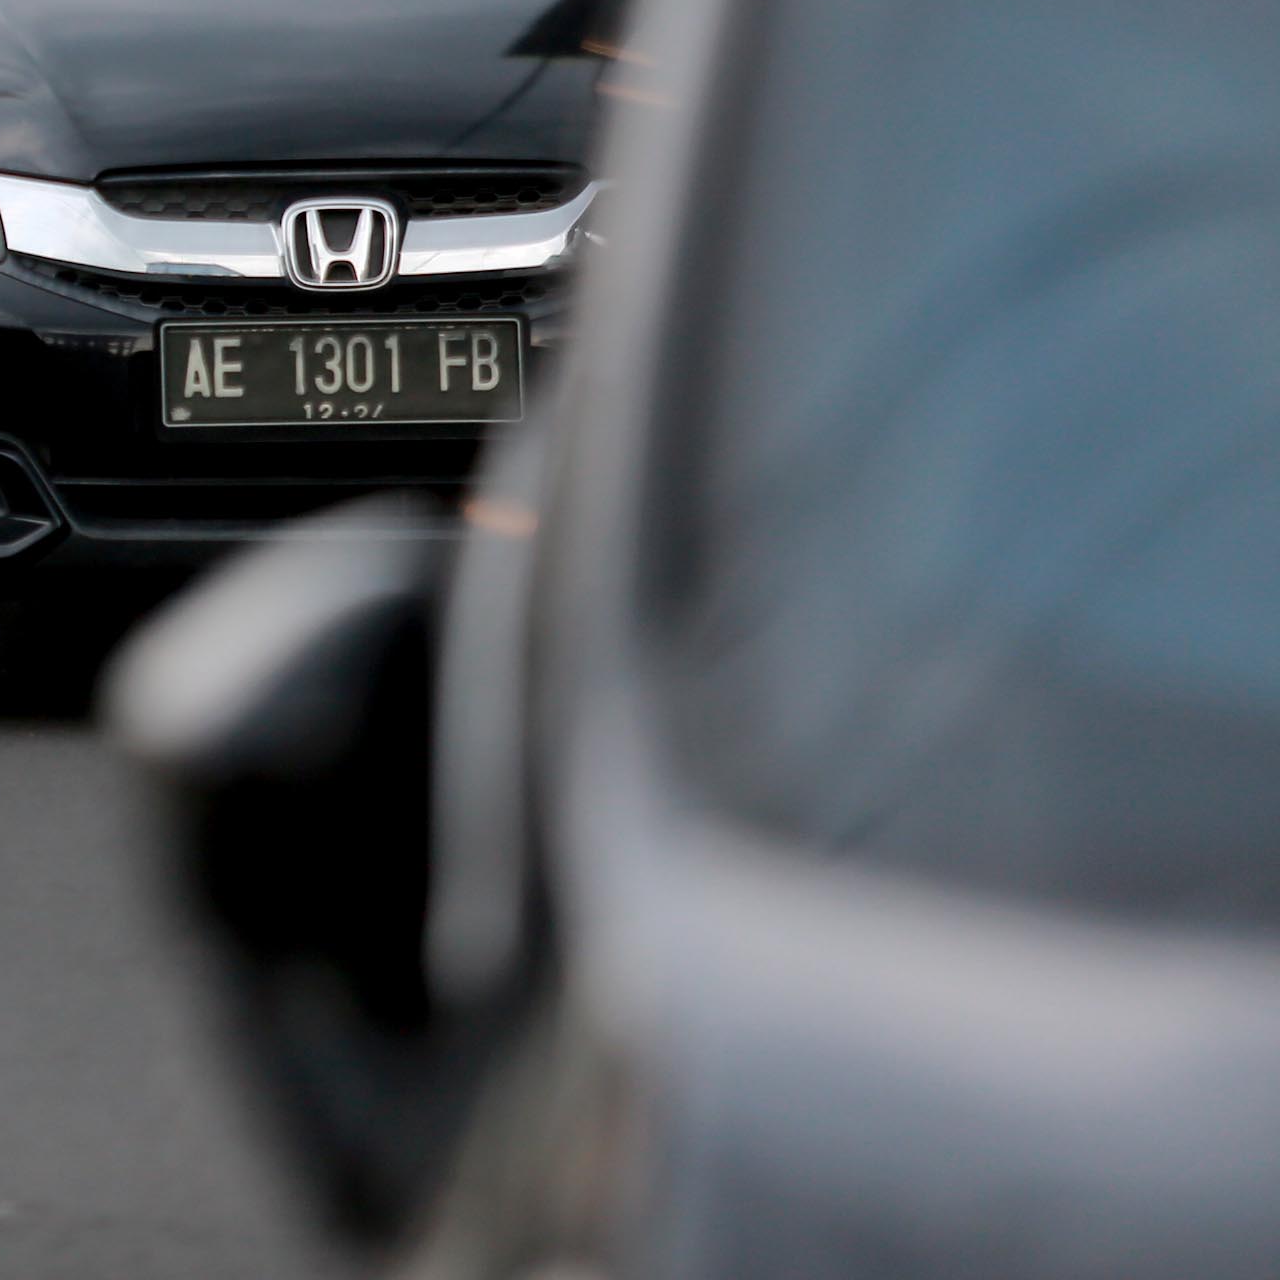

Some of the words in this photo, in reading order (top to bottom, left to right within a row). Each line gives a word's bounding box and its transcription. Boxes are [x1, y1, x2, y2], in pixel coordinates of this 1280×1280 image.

[184, 337, 245, 398] AE
[289, 333, 400, 396] 1301
[439, 329, 500, 393] FB
